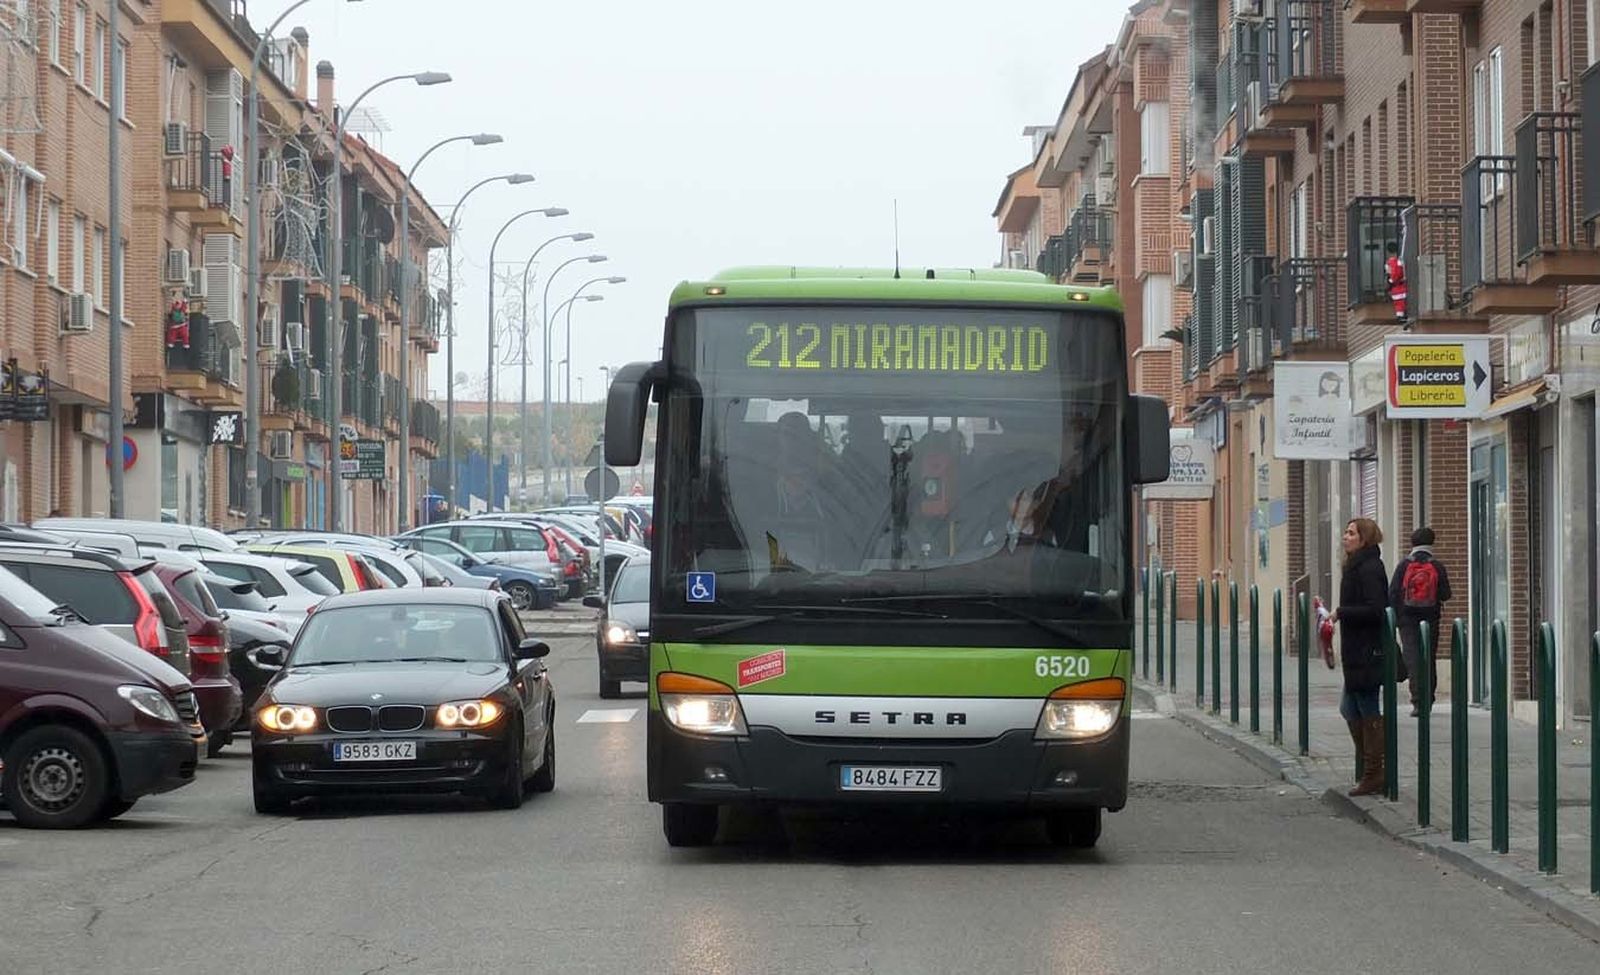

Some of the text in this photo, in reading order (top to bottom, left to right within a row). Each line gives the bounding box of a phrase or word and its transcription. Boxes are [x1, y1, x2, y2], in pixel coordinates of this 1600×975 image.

[747, 322, 1048, 371] 212 MIRAMADRID
[1401, 369, 1460, 385] Lapiceros
[1292, 427, 1332, 440] Infantil
[1034, 656, 1090, 677] 6520
[815, 711, 967, 725] SETRA
[343, 743, 412, 758] 9583 GKZ
[853, 769, 937, 786] 8484 FZZ
